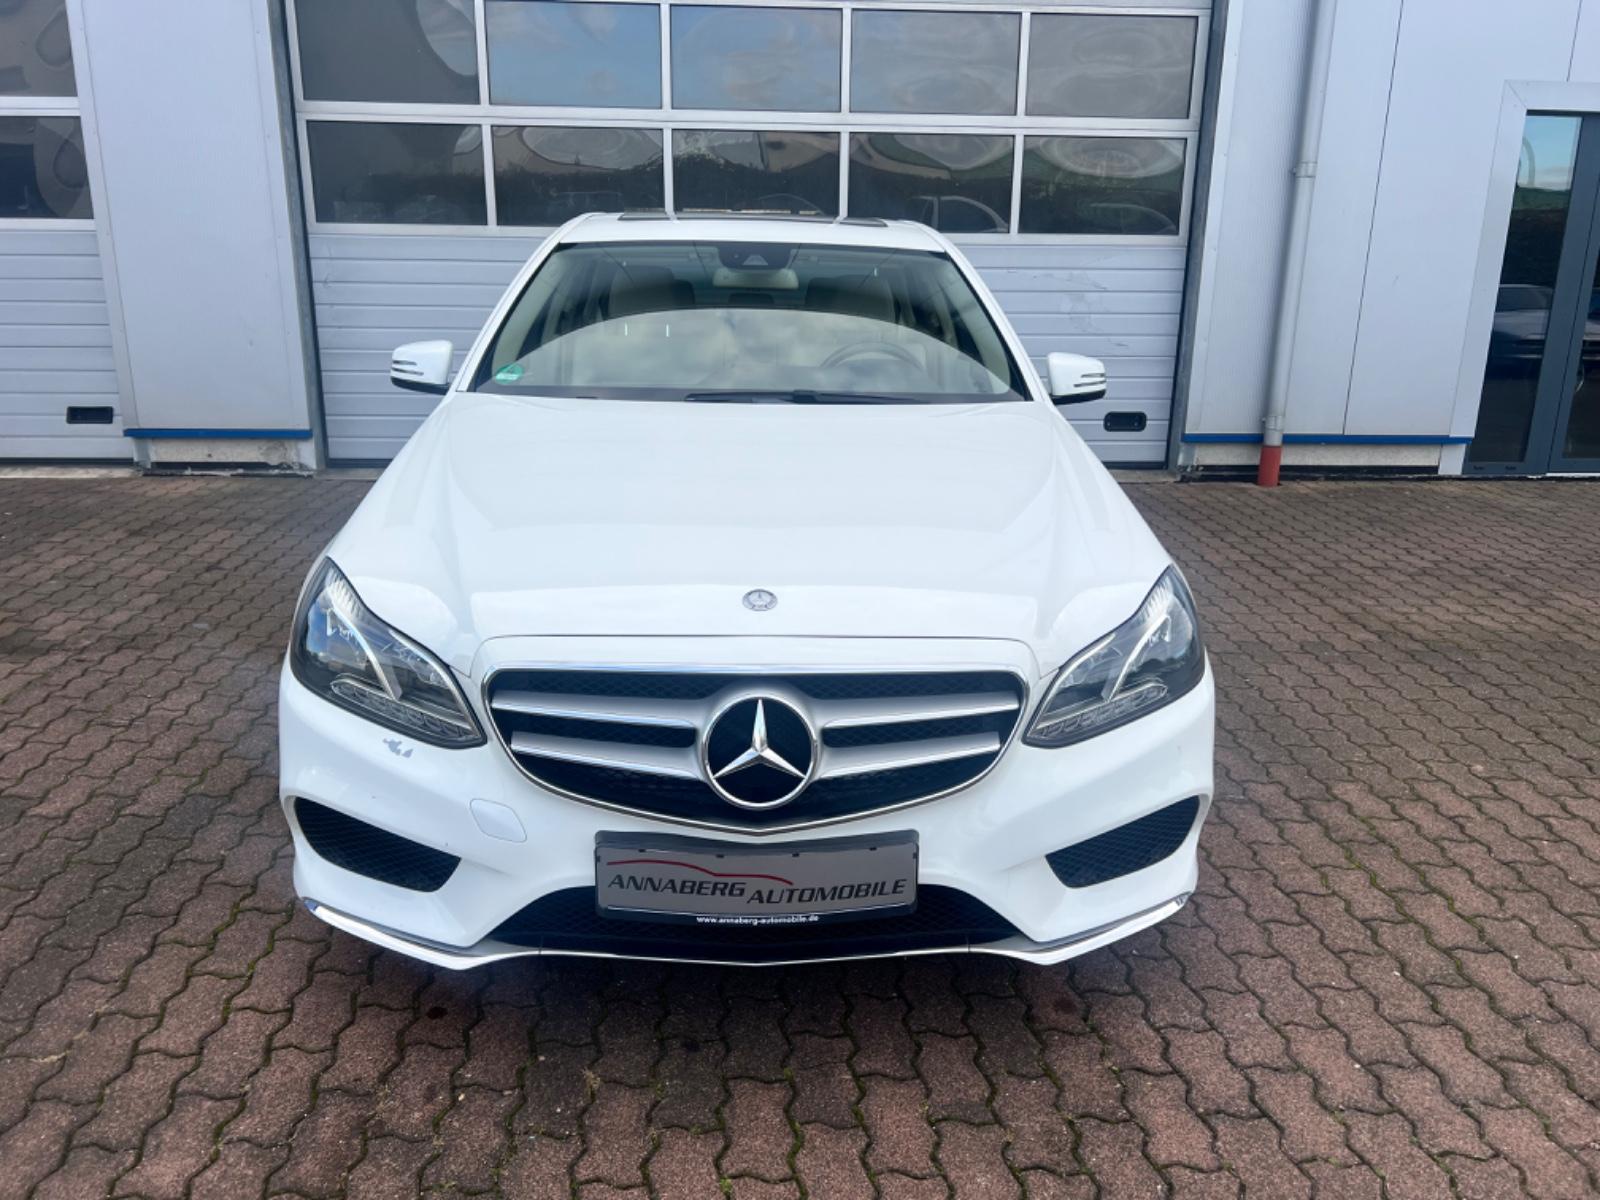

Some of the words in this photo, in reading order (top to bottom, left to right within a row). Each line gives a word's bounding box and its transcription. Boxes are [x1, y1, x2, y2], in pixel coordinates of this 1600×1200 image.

[607, 874, 746, 898] ANNABERG
[746, 878, 906, 904] AUTOMOBILE
[696, 914, 819, 926] www.annaberg-automobile.de
